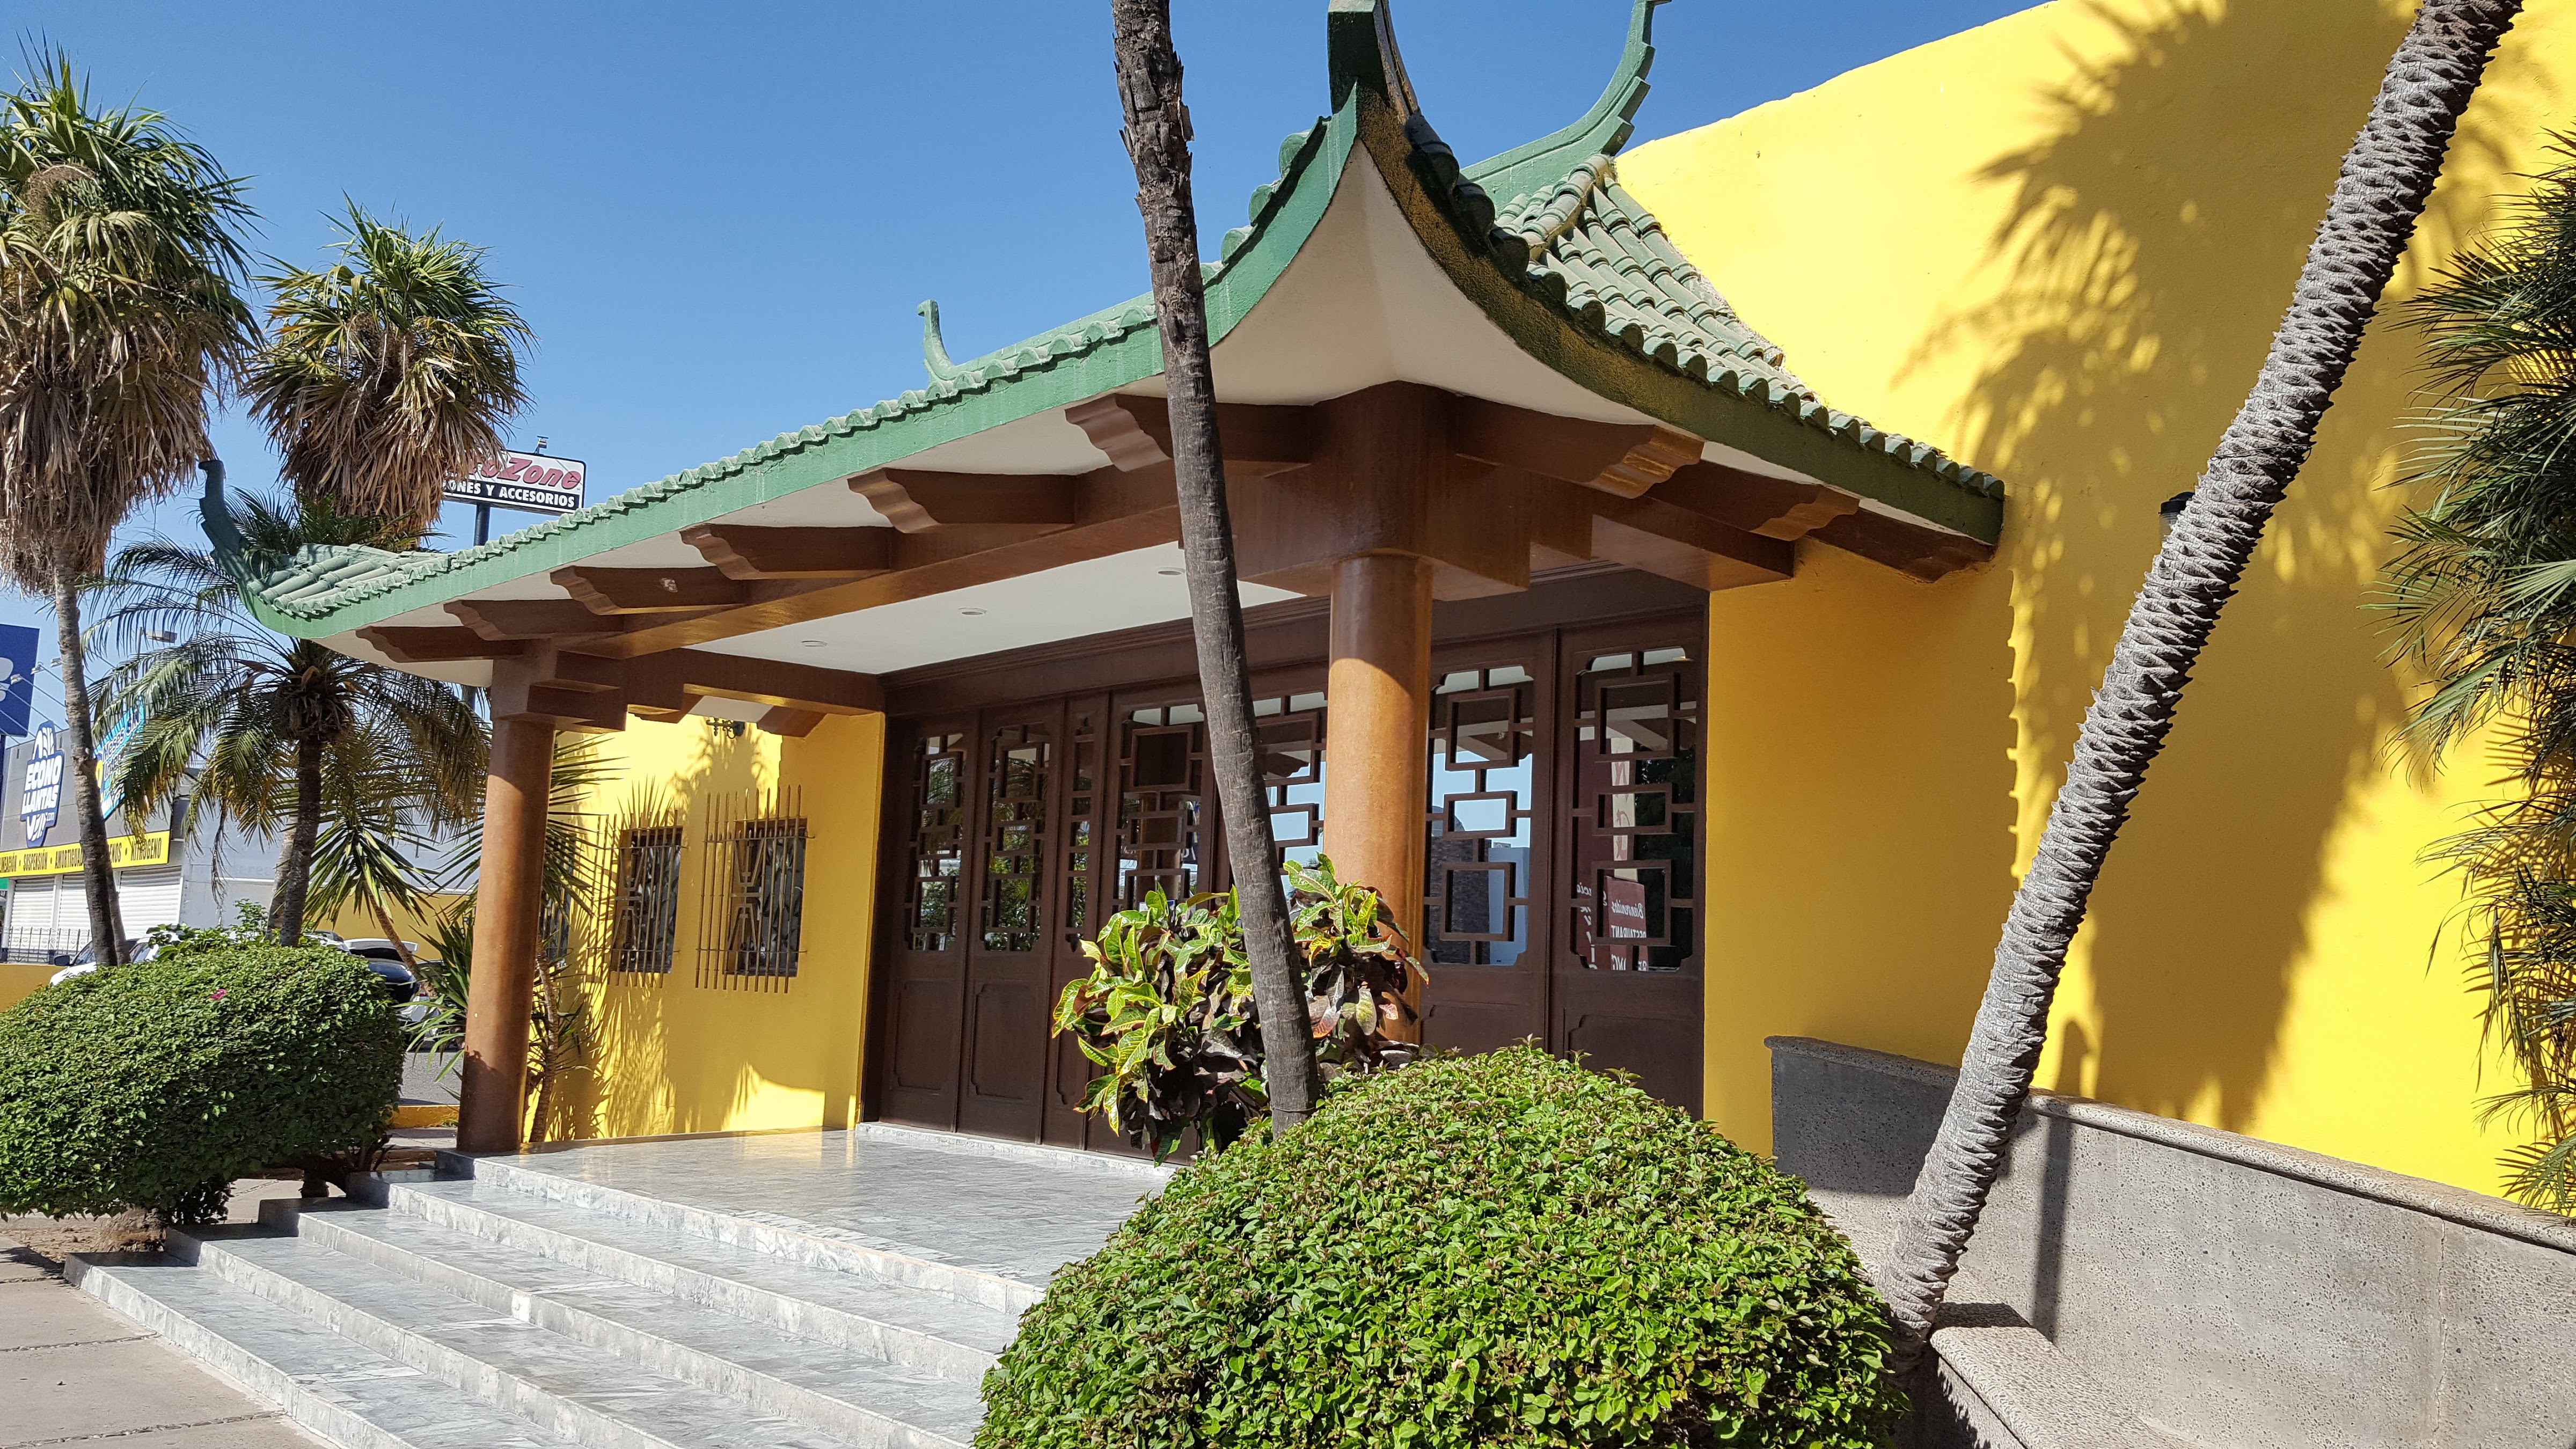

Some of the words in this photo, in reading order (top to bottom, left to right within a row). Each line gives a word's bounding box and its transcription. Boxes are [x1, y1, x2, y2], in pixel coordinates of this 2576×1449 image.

[469, 457, 581, 489] oZone
[486, 484, 495, 496] Y
[499, 487, 575, 508] ACCESORIOS
[25, 755, 62, 791] ECONO
[21, 785, 59, 815] LLANTAS
